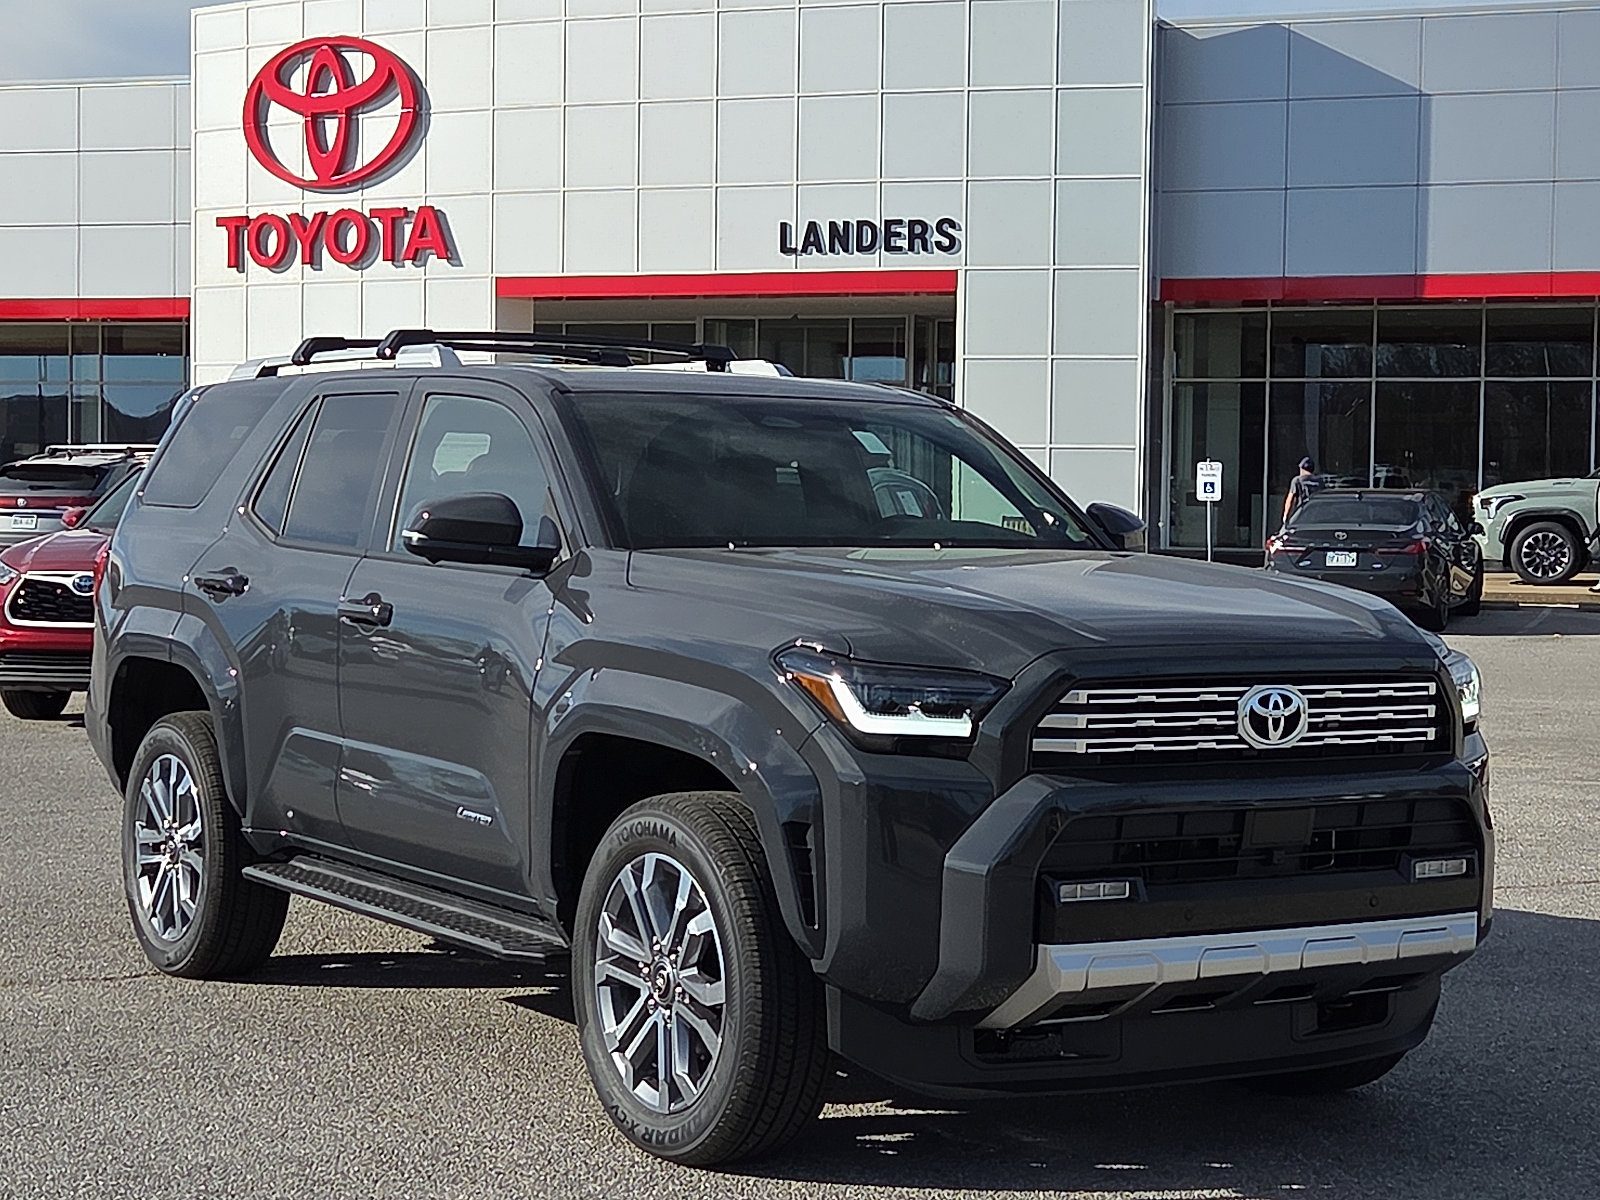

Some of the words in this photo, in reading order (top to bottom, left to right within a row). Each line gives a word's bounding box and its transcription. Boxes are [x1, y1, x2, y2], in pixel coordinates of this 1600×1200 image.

[216, 205, 453, 268] TOYOTA
[779, 217, 960, 254] LANDERS
[615, 820, 678, 848] YOKOHAMA
